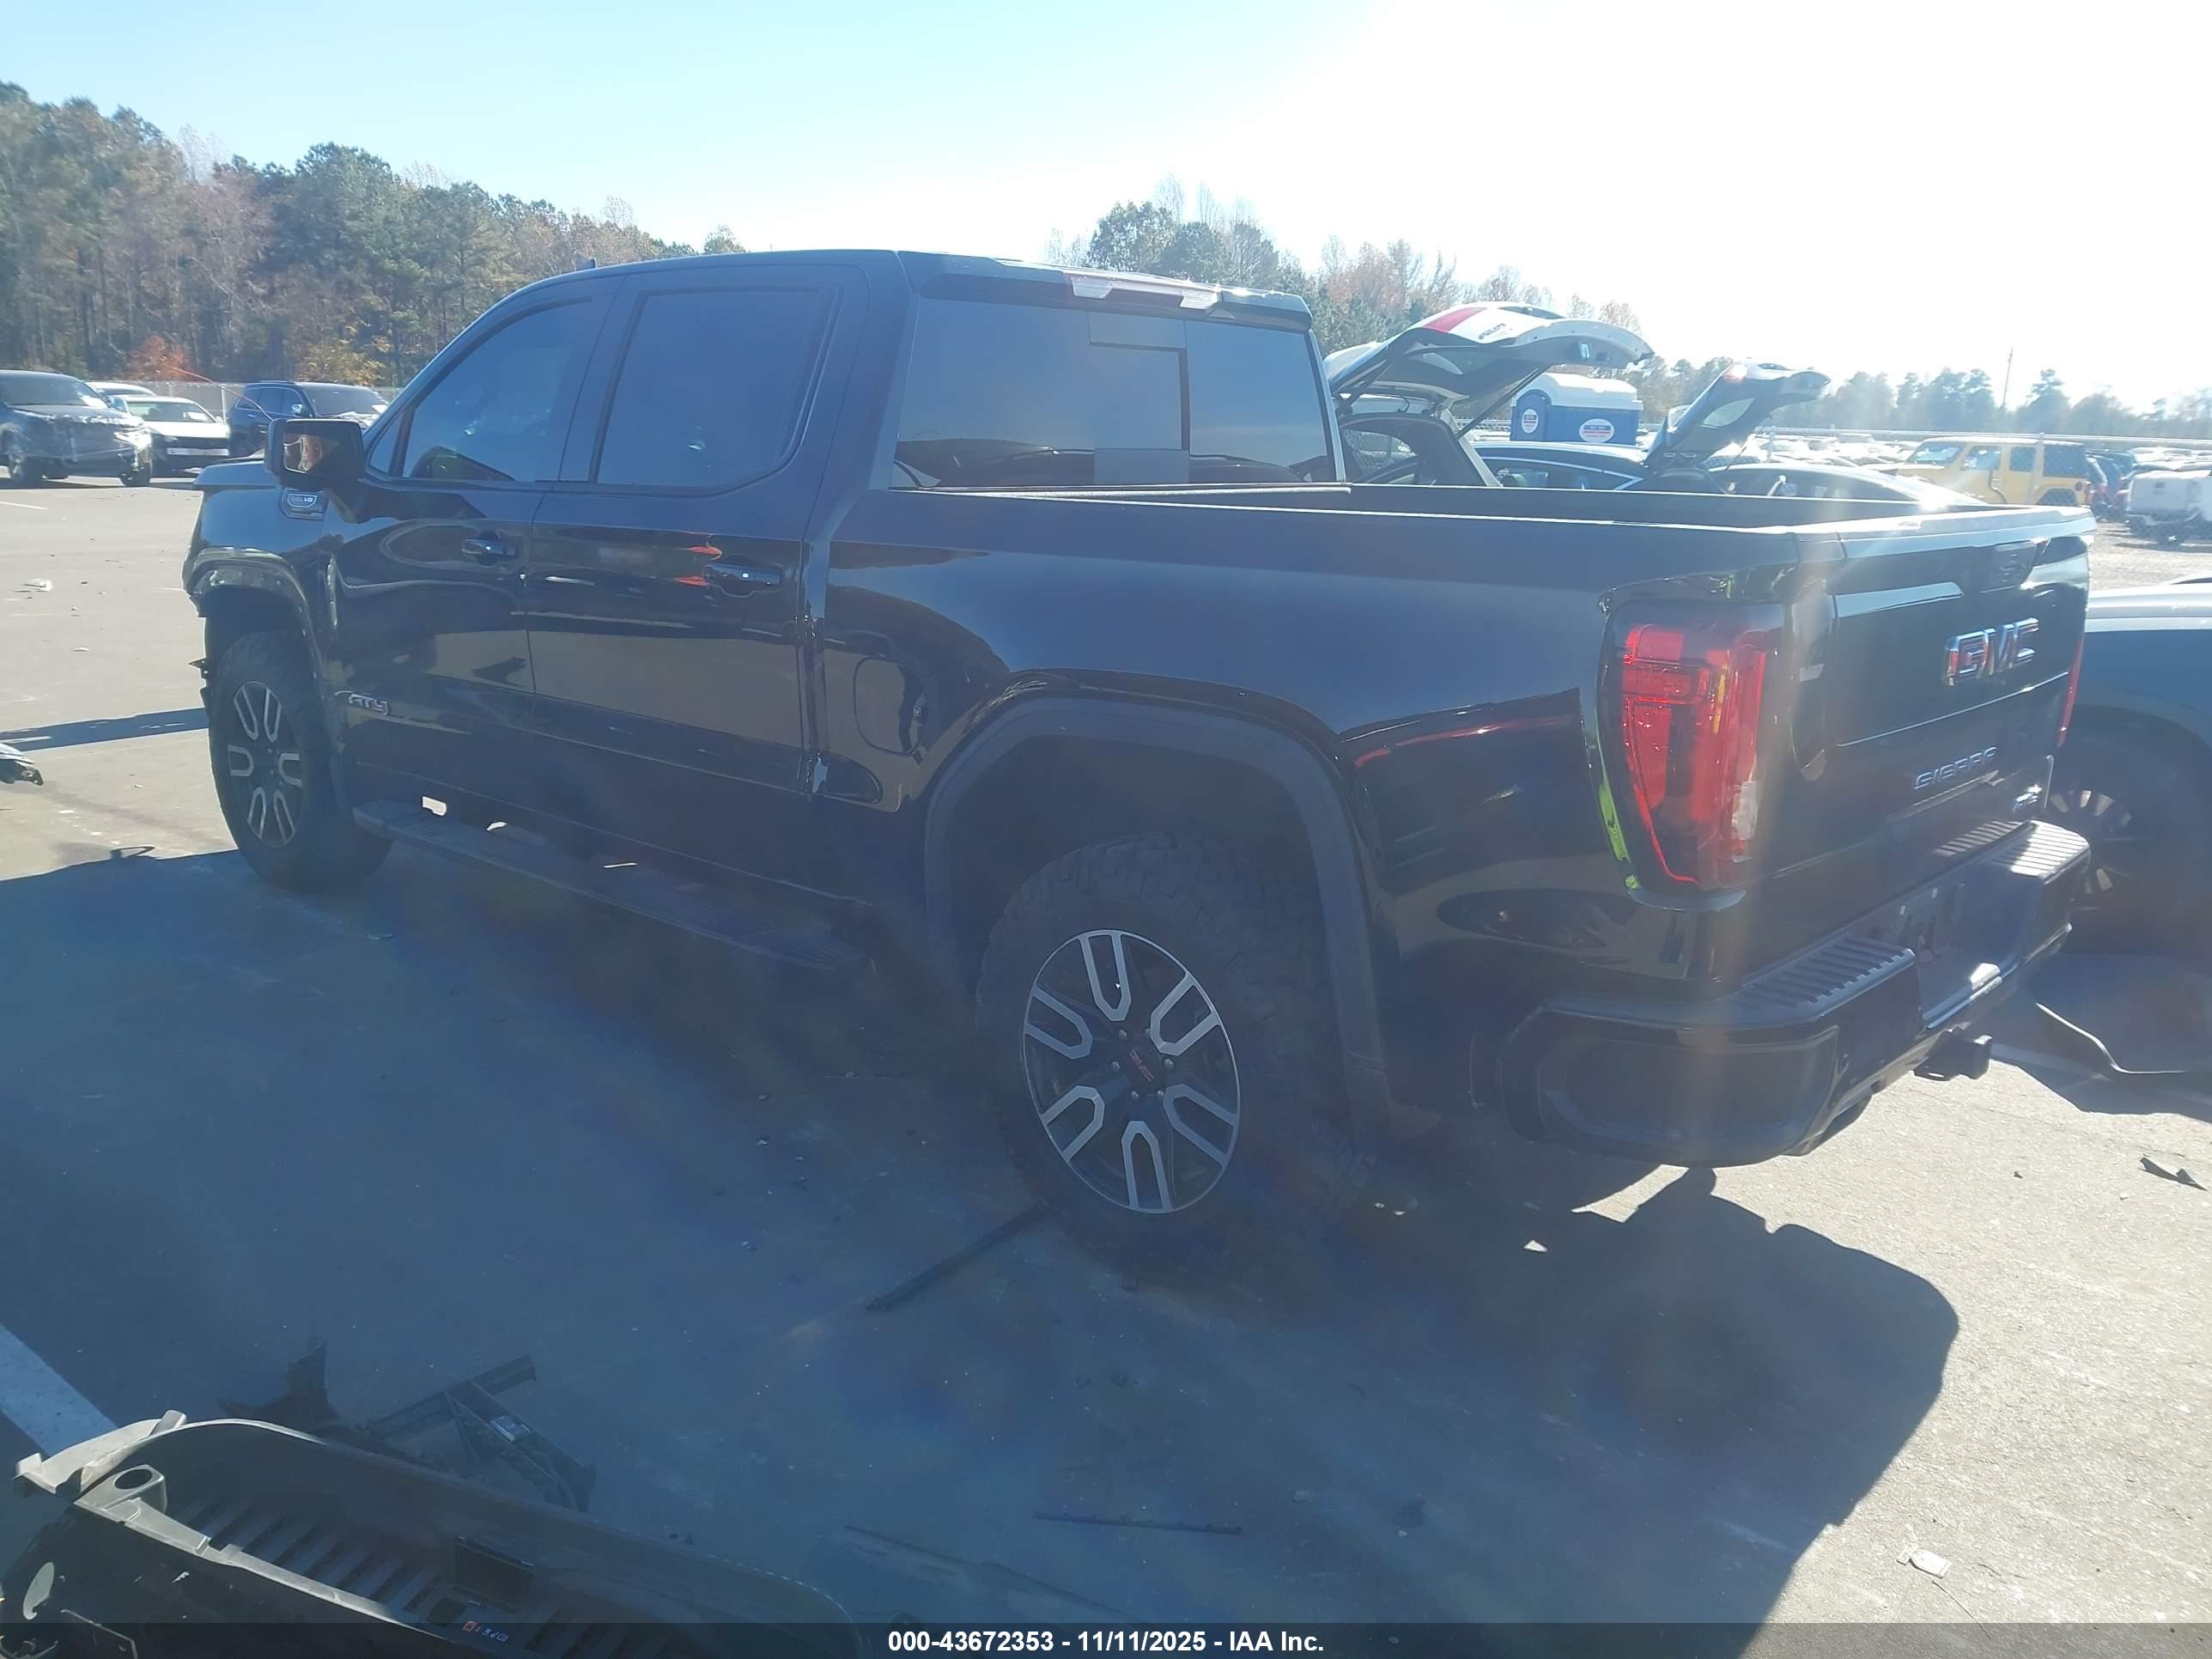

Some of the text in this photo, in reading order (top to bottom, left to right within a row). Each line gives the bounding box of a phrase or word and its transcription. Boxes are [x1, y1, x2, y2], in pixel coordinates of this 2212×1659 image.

[1944, 617, 2040, 686] GMC
[348, 693, 388, 715] AT4
[1914, 746, 1998, 790] SIERRA
